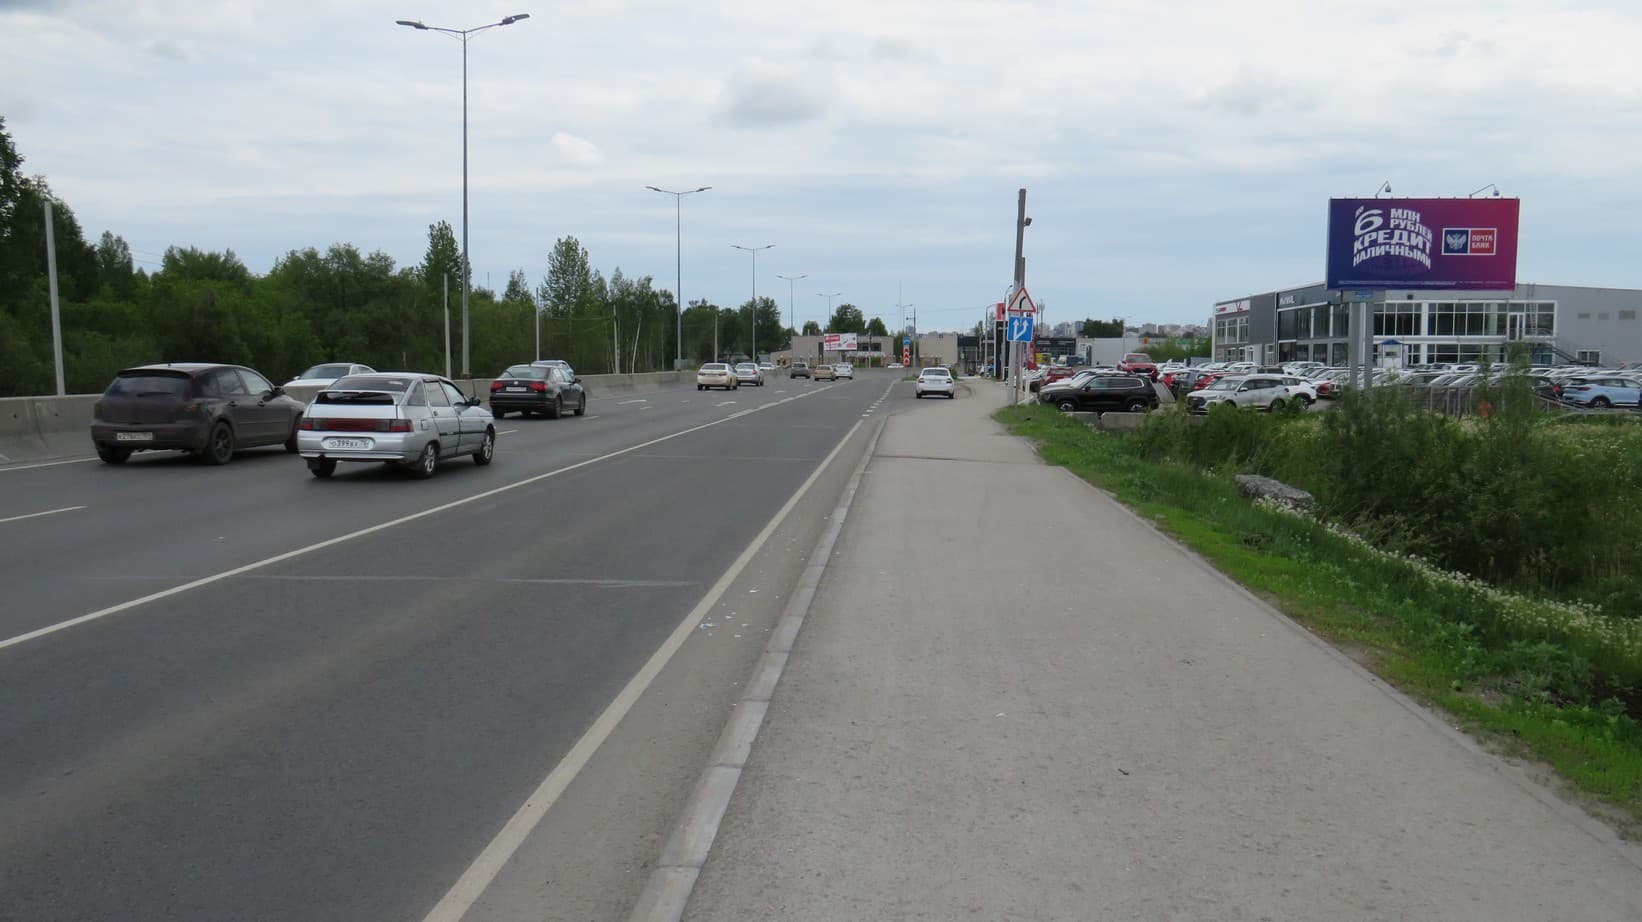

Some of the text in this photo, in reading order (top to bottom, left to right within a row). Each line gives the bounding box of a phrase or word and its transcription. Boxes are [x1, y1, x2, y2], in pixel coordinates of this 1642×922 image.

[1354, 208, 1421, 236] 6 МЛН
[1353, 229, 1431, 255] КРЕДИТ
[1472, 234, 1494, 242] ПОЧТА
[1353, 244, 1432, 270] НАЛИЧНЫМИ
